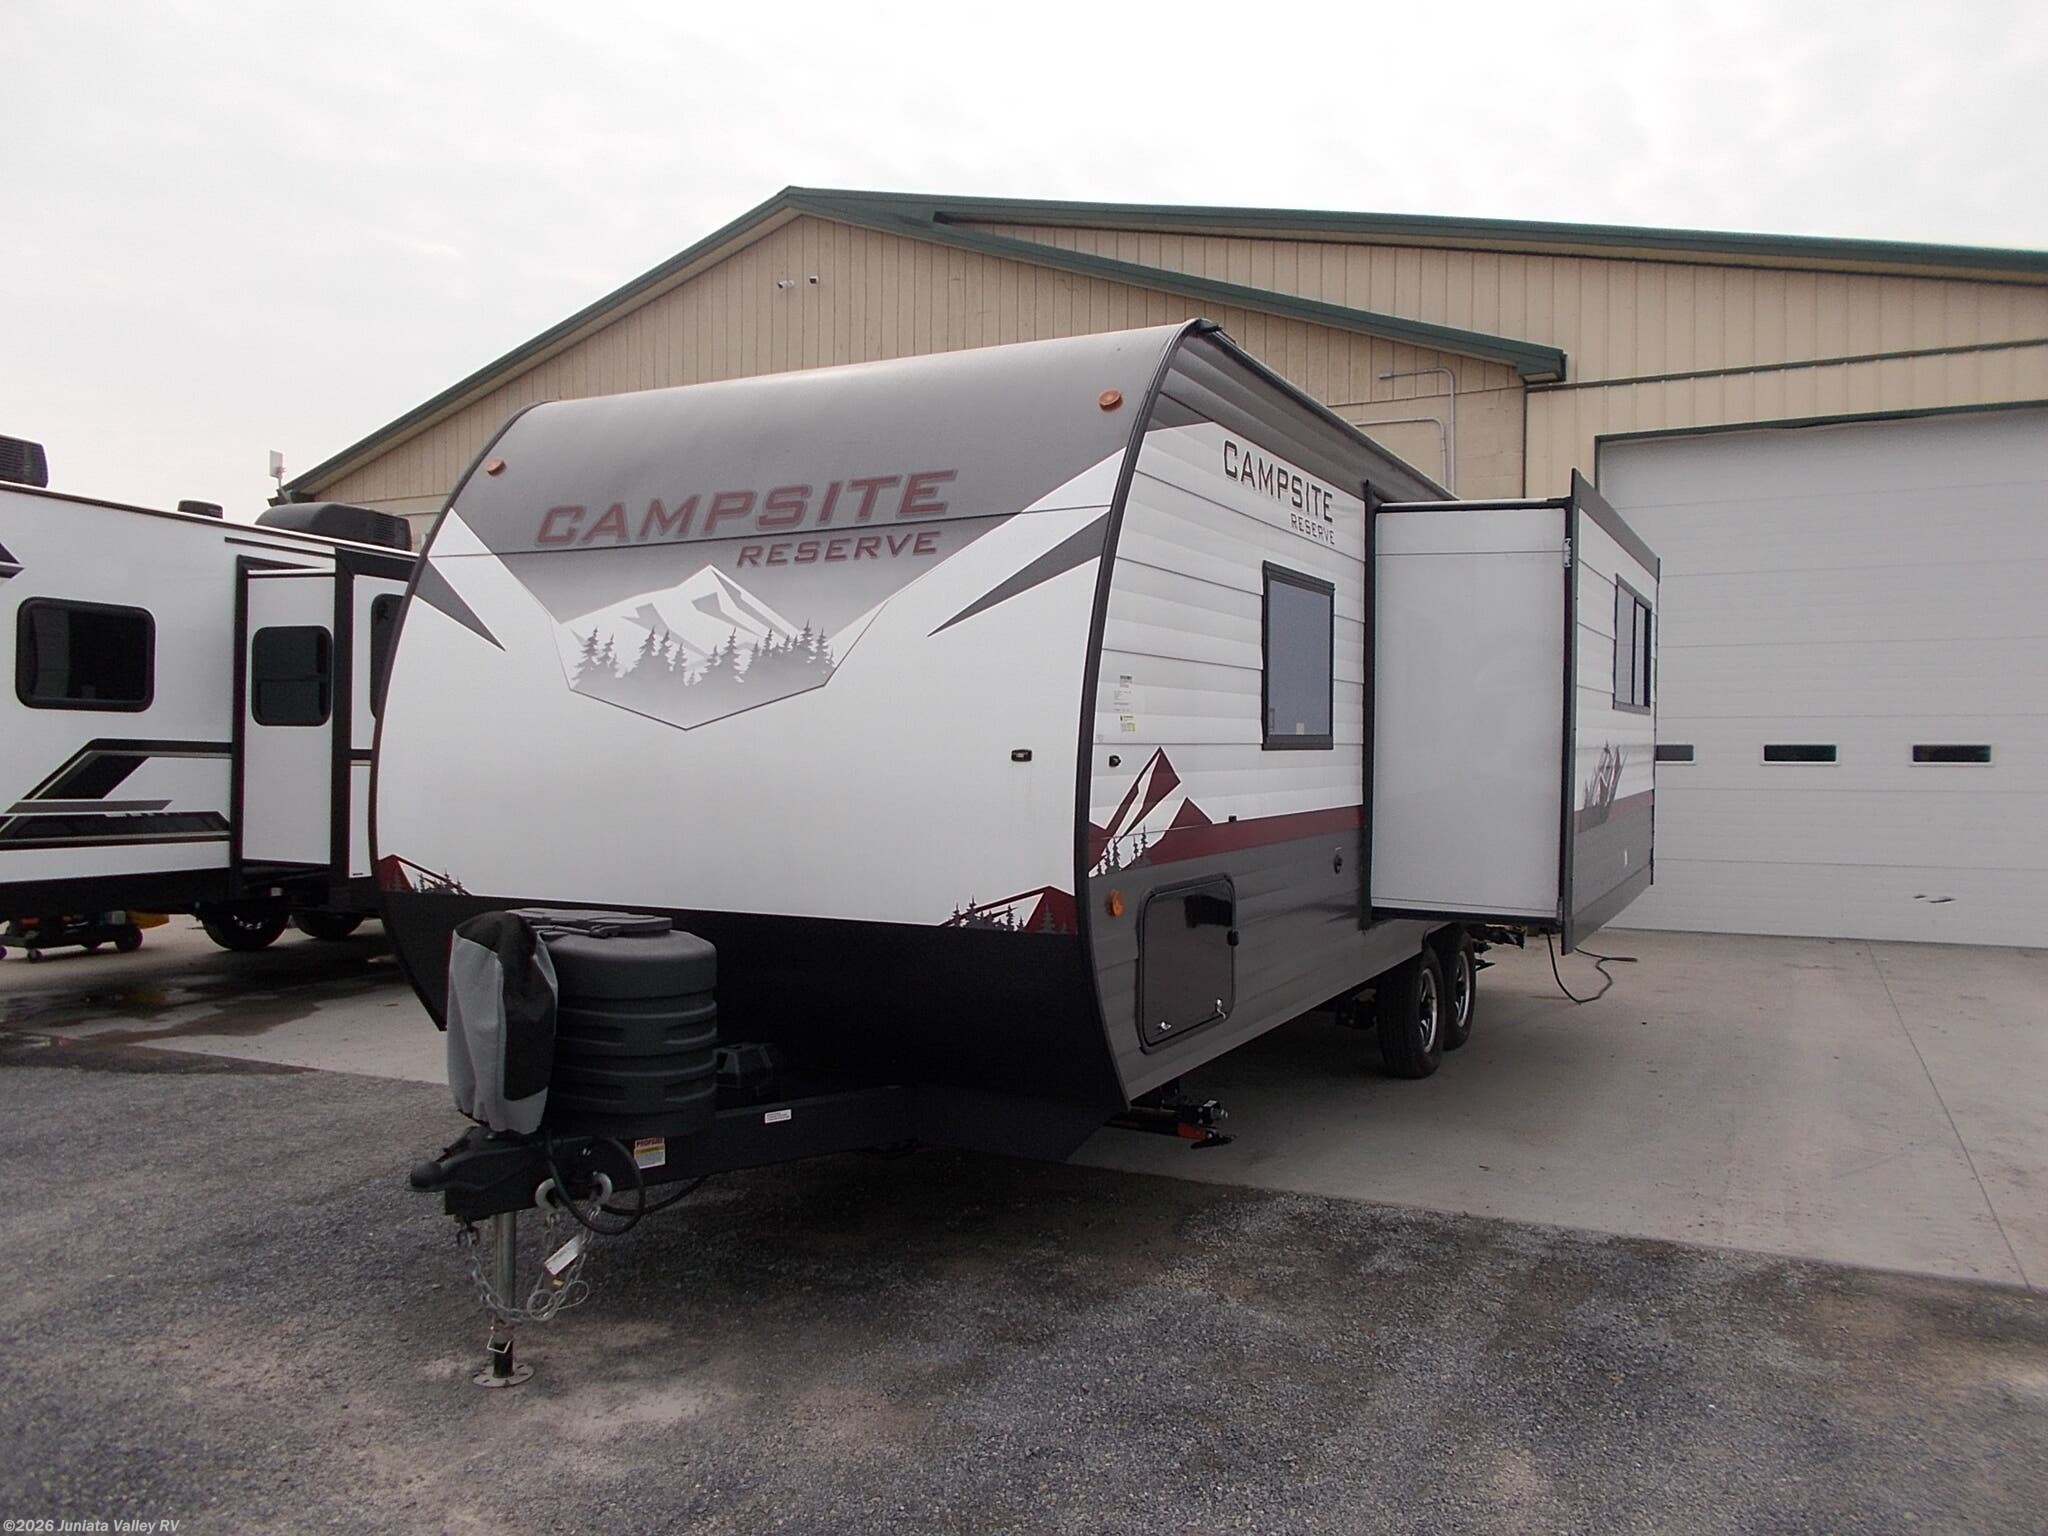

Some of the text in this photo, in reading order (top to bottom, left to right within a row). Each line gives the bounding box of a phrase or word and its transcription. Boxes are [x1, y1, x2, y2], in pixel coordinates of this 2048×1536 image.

[535, 469, 957, 547] CAMPSITE
[1224, 440, 1333, 523] CAMPSITE
[737, 531, 941, 568] RESERVE
[1290, 512, 1335, 545] RESERVE
